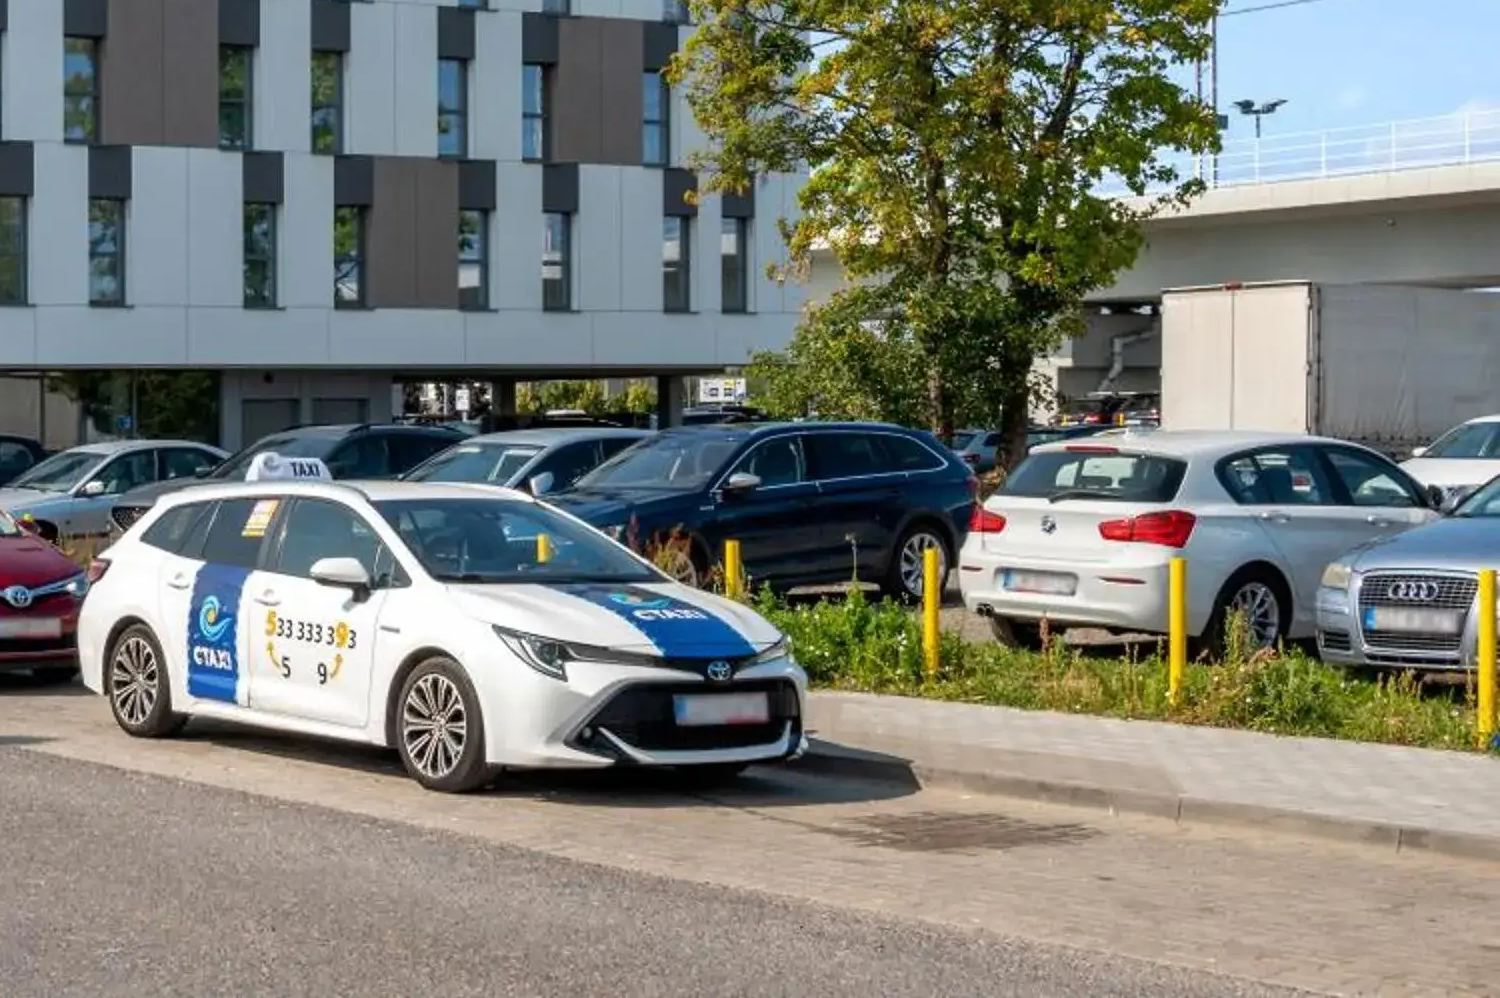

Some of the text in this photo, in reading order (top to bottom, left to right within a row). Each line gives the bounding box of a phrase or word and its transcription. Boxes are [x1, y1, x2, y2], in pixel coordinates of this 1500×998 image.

[290, 461, 321, 477] TAXI
[265, 609, 357, 649] 533 333 393
[281, 655, 292, 679] 5
[317, 661, 328, 685] 9
